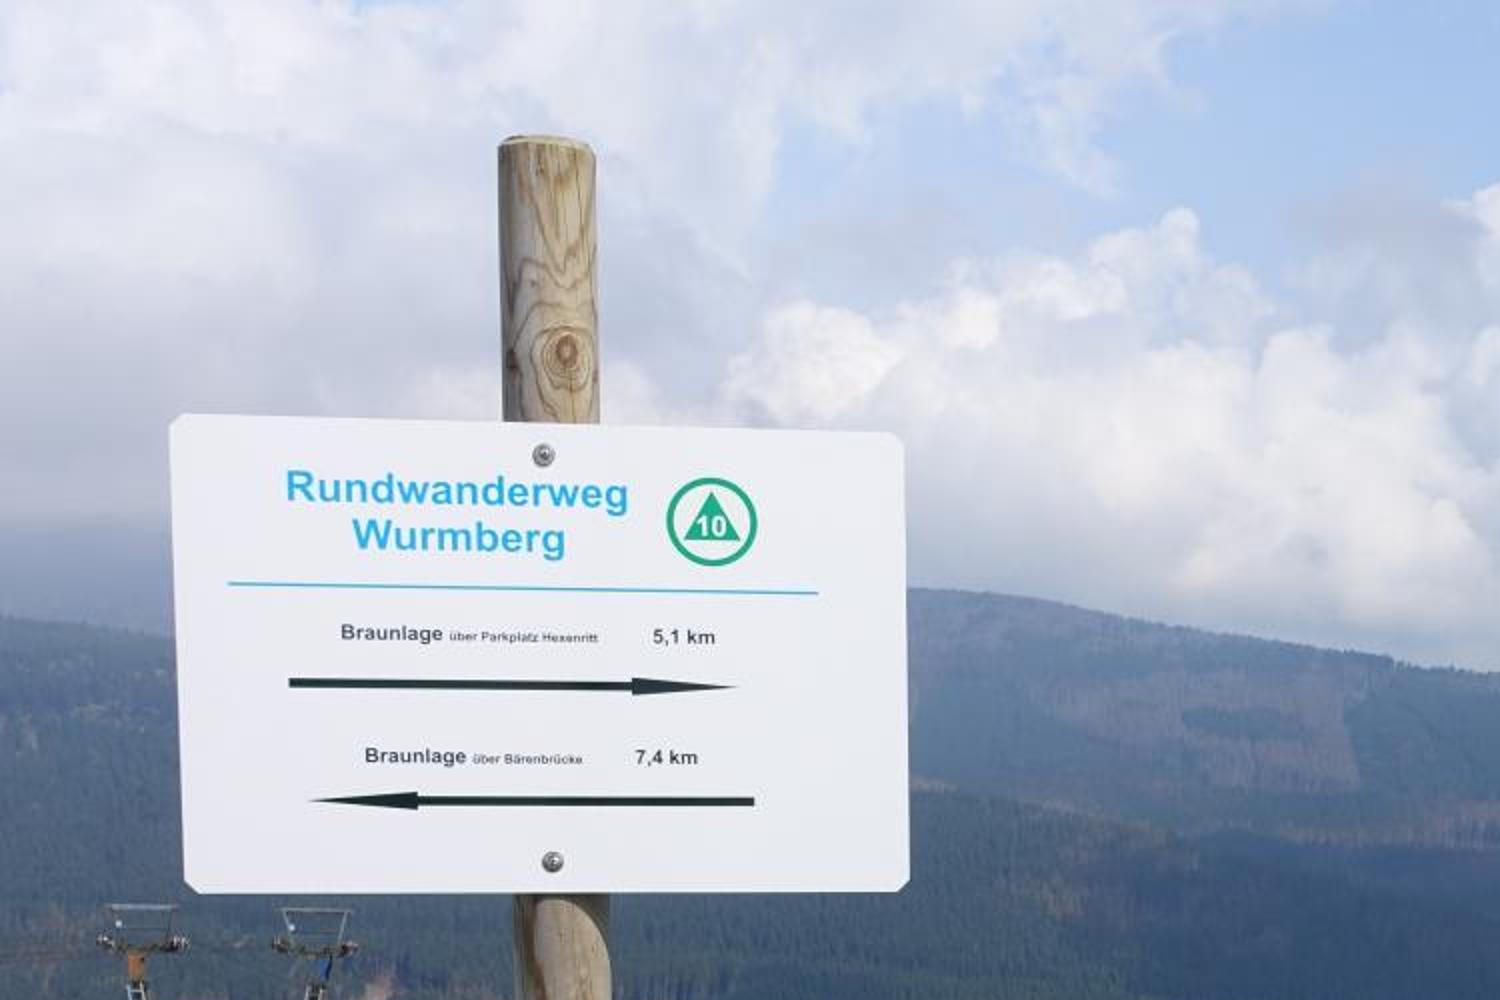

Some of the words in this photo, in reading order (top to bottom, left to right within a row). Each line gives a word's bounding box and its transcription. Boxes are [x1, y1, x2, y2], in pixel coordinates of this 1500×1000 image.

[286, 469, 629, 515] Rundwanderweg
[696, 515, 727, 537] 10
[352, 517, 566, 561] Wurmberg
[340, 623, 443, 645] Braunlage
[449, 630, 477, 642] über
[481, 631, 539, 644] Parkplatz
[542, 632, 599, 643] Hexenritt
[653, 629, 679, 646] 5,1
[686, 629, 716, 645] km
[365, 747, 467, 768] Braunlage
[472, 753, 501, 765] über
[503, 753, 583, 765] Bärenbrücke
[635, 749, 664, 767] 7,4
[669, 749, 698, 765] km
